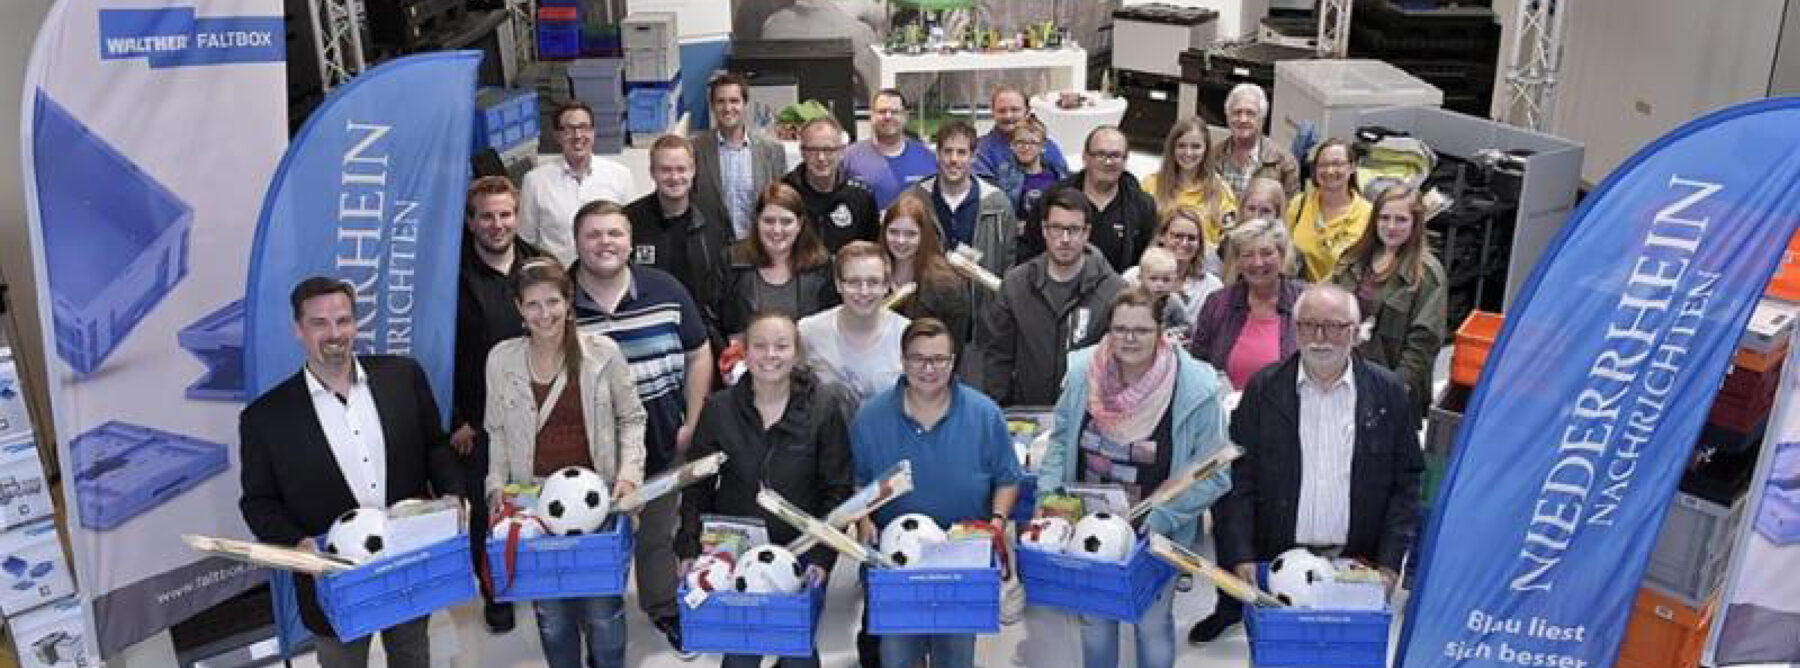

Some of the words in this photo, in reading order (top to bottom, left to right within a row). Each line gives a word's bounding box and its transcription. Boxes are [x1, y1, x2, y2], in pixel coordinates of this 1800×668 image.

[106, 34, 189, 53] WALTHER
[197, 31, 272, 49] FALTBOX
[1510, 173, 1725, 592] NIEDERRHEIN
[1587, 269, 1723, 527] NACHRICHTEN
[1528, 616, 1585, 642] liest
[1499, 643, 1588, 668] besser
